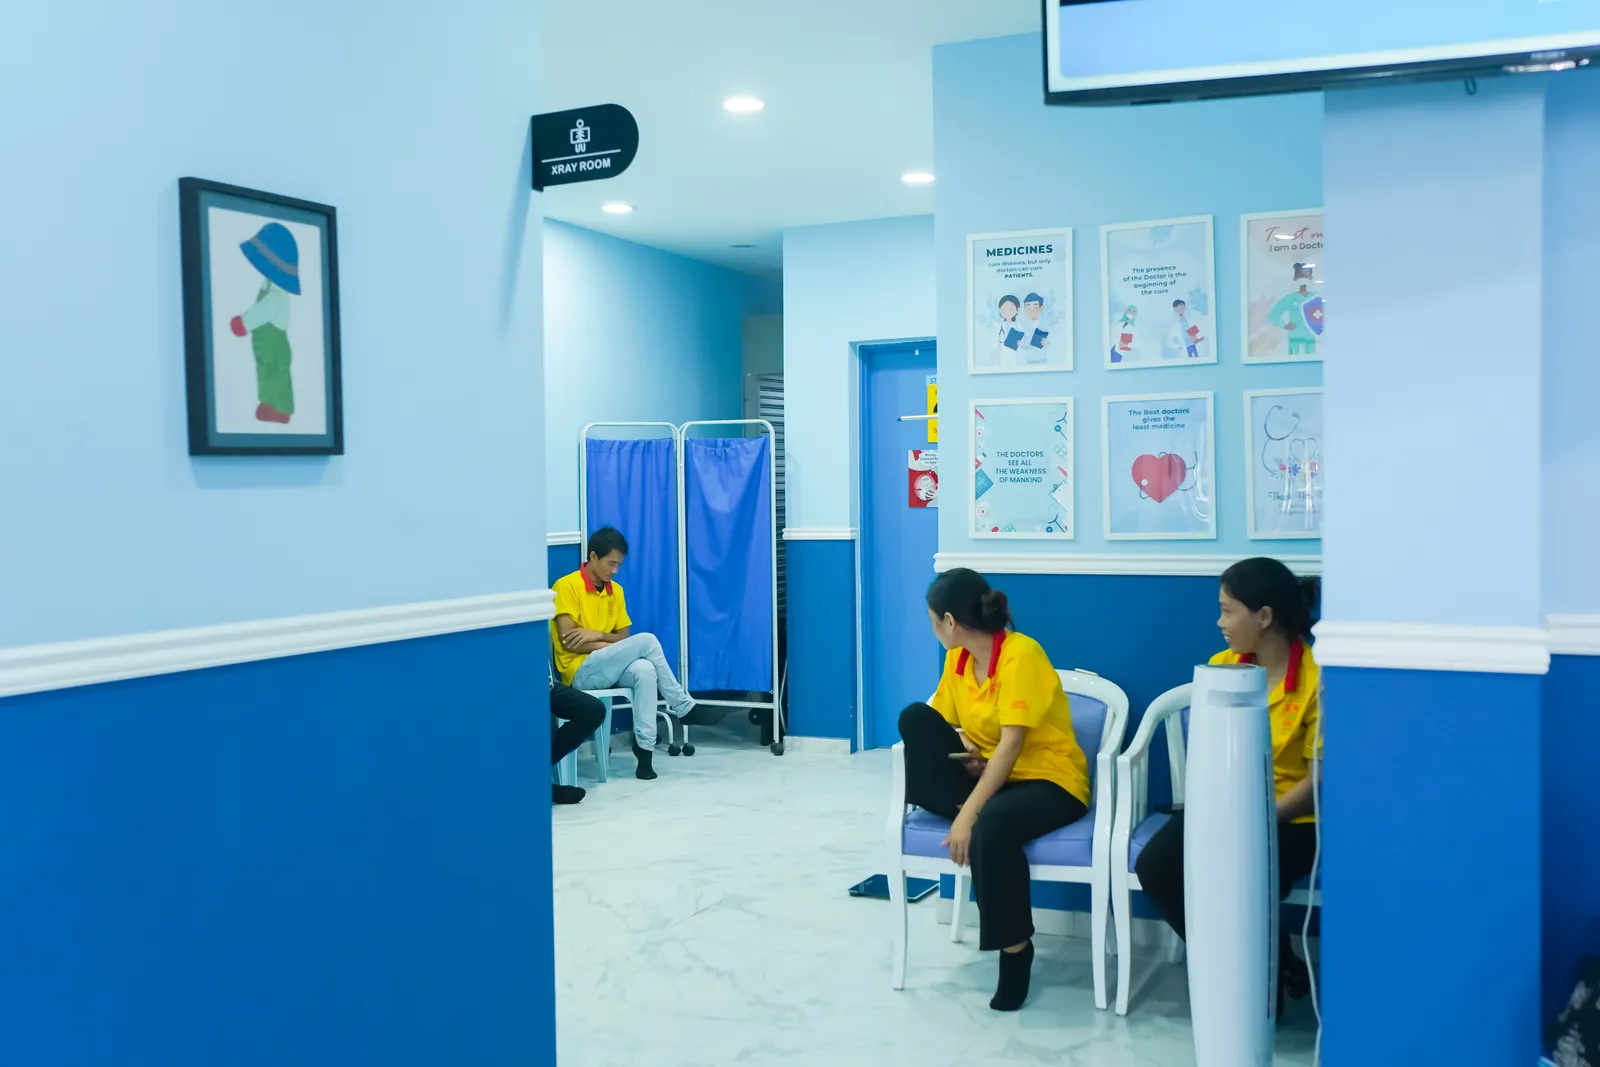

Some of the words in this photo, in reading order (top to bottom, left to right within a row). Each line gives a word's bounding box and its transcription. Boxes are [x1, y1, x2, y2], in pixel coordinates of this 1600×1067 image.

[551, 162, 578, 175] XRAY
[579, 157, 611, 172] ROOM
[986, 244, 1053, 257] MEDICINES
[1146, 265, 1177, 273] presence
[929, 377, 937, 385] ST
[1142, 416, 1162, 424] gives
